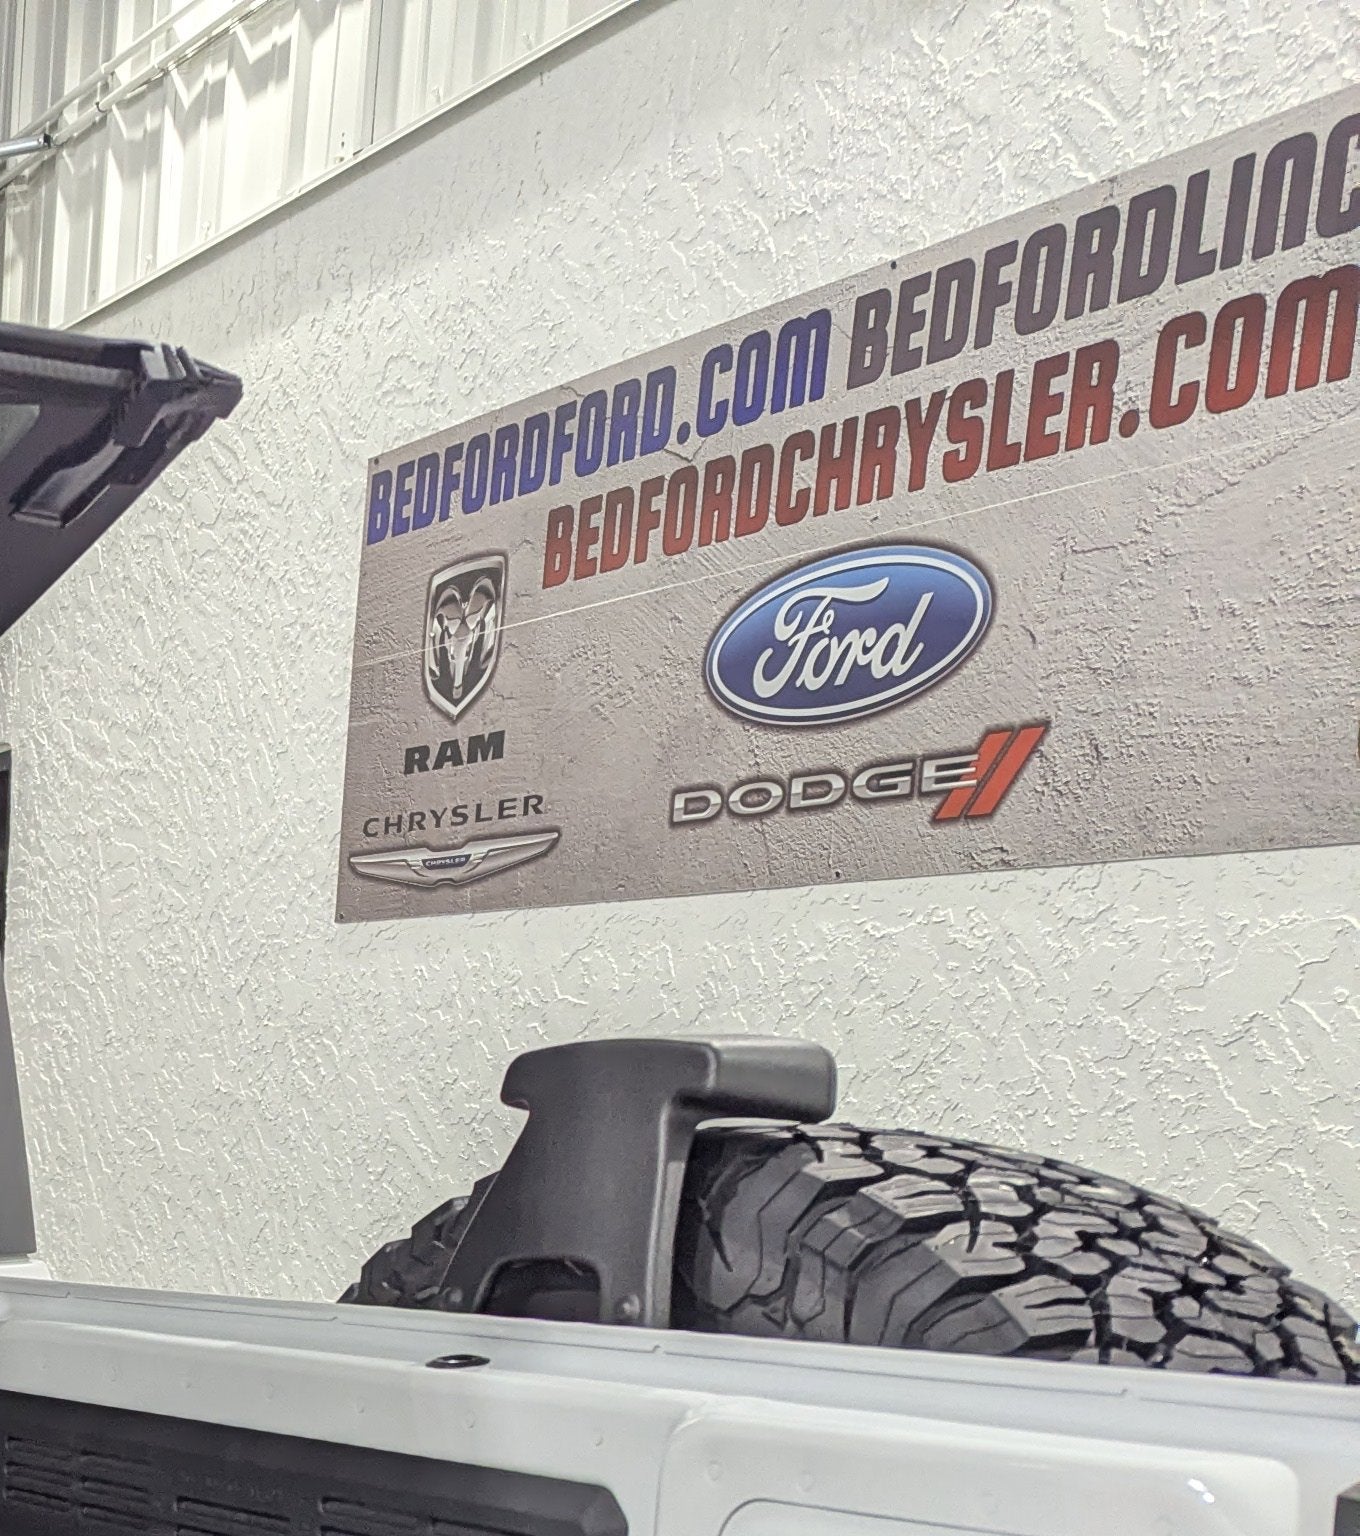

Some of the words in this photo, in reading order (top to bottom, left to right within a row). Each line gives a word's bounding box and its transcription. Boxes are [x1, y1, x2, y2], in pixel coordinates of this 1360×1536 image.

[367, 308, 832, 546] BEDFORDFORD.COM
[542, 264, 1360, 590] BEDFORDCHRYSLER.COM
[752, 577, 933, 697] Ford
[404, 730, 506, 774] RAM
[670, 754, 982, 828] DODGE
[362, 793, 545, 838] CHRYSLER
